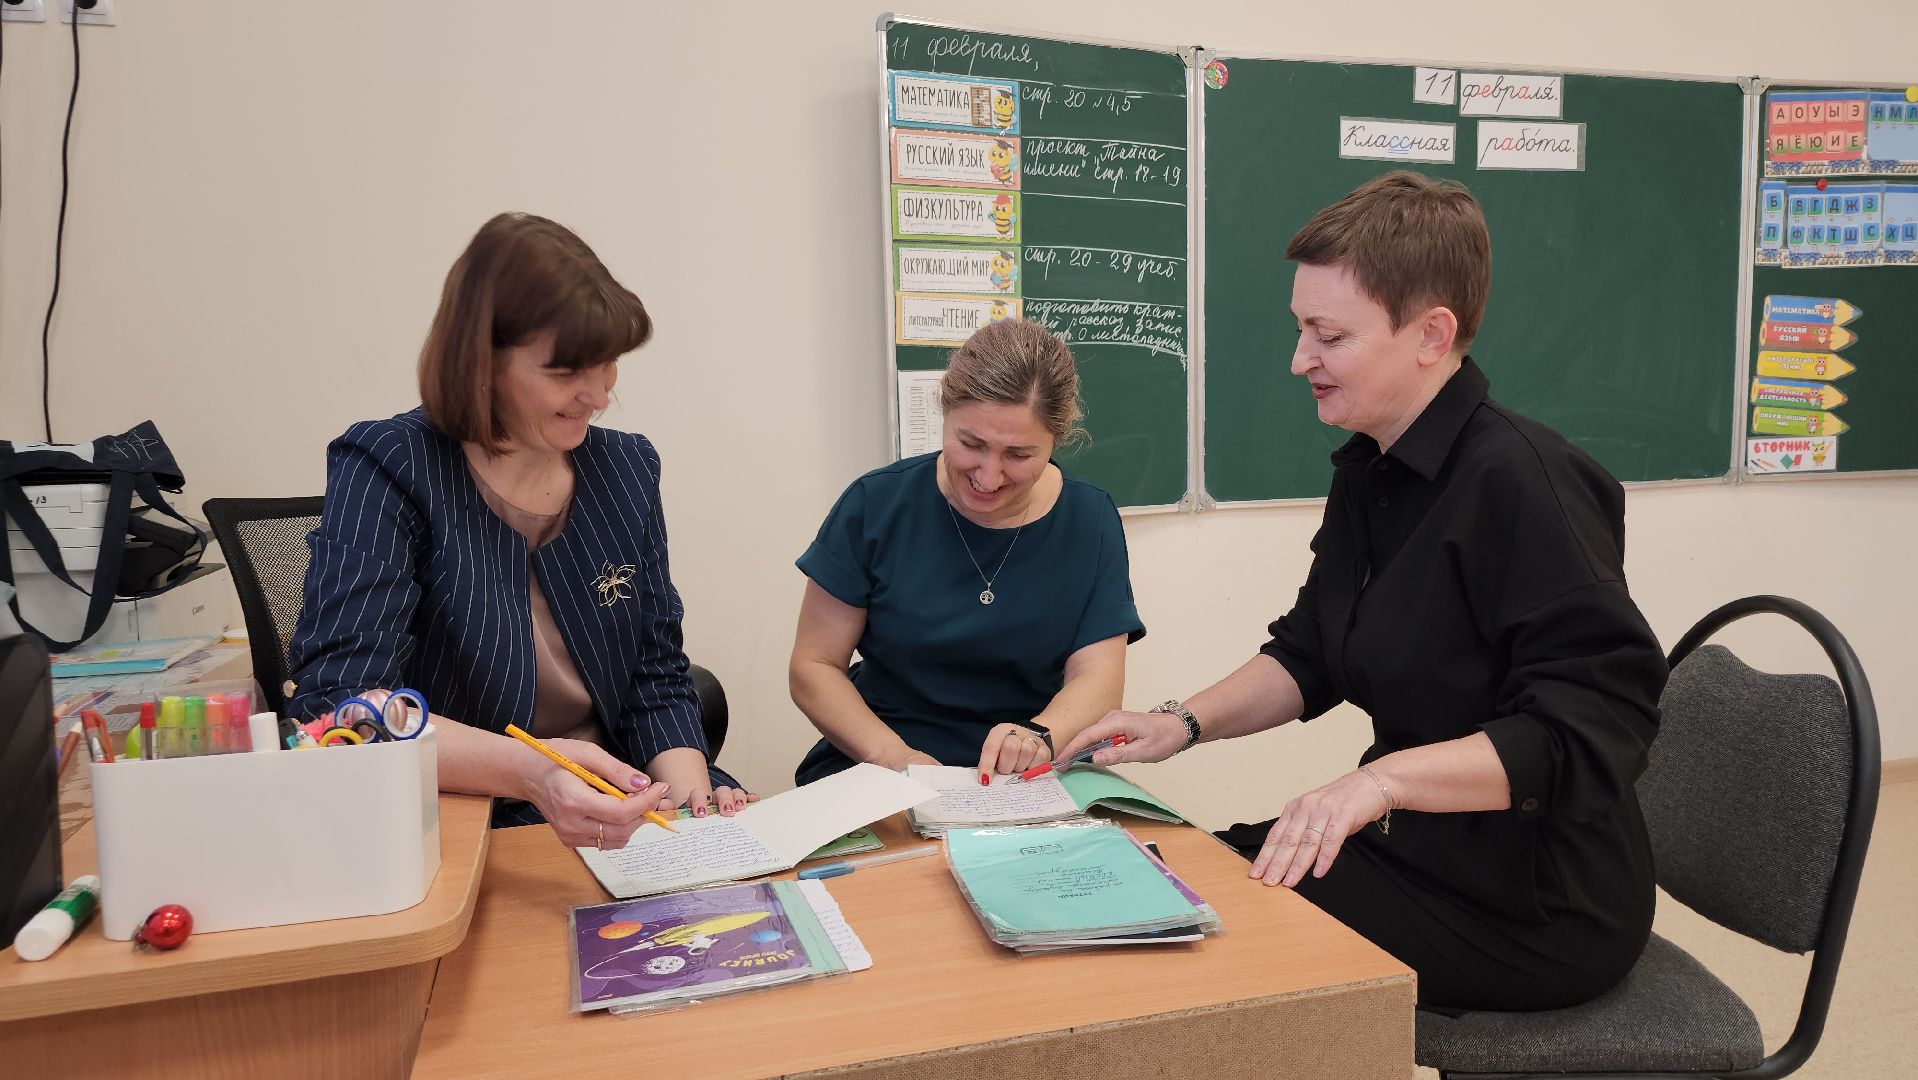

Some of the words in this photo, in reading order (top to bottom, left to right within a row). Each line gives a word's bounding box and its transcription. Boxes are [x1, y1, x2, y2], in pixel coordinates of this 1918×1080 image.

[891, 36, 910, 60] 11
[1425, 72, 1455, 96] 11
[901, 84, 970, 110] МАТЕМАТИКА
[1022, 85, 1058, 119] стр.
[1063, 88, 1086, 109] 20
[1777, 107, 1785, 119] А
[1795, 106, 1804, 119] О
[1812, 106, 1821, 118] У
[1829, 105, 1840, 118] Ы
[1851, 105, 1860, 117] Э
[1875, 106, 1883, 119] Н
[1890, 106, 1902, 119] М
[1343, 125, 1451, 149] Классная
[1776, 138, 1785, 150] Я
[1795, 135, 1802, 149] Ё
[1810, 136, 1822, 148] Ю
[1831, 135, 1840, 147] И
[1851, 135, 1859, 147] Е
[906, 142, 955, 167] РУССКИЙ
[958, 148, 985, 169] ЯЗЫК
[1026, 140, 1091, 167] проект
[903, 197, 984, 221] ФИЗКУЛЬТУРА
[1769, 196, 1778, 208] Б
[1795, 201, 1803, 212] В
[1812, 200, 1820, 212] Г
[1829, 200, 1841, 214] Д
[1845, 200, 1858, 211] Ж
[1866, 198, 1873, 209] З
[1792, 228, 1802, 240] Ф
[1812, 227, 1821, 239] К
[1830, 228, 1838, 239] Т
[1845, 228, 1858, 241] Ш
[1867, 225, 1875, 237] С
[1887, 227, 1896, 239] Х
[1906, 227, 1915, 240] Ц
[904, 256, 969, 279] ОКРУЖАЮЩИЙ
[971, 260, 990, 277] МИР
[1024, 247, 1061, 281] стр.
[1069, 249, 1092, 267] 20
[909, 316, 944, 327] ЛИТЕРАТУРНОЕ
[943, 308, 980, 329] ЧТЕНИЕ
[1771, 306, 1820, 316] МАТЕМАТИКА
[1773, 325, 1808, 334] РУССКИЙ
[718, 949, 796, 968] JOURNEY
